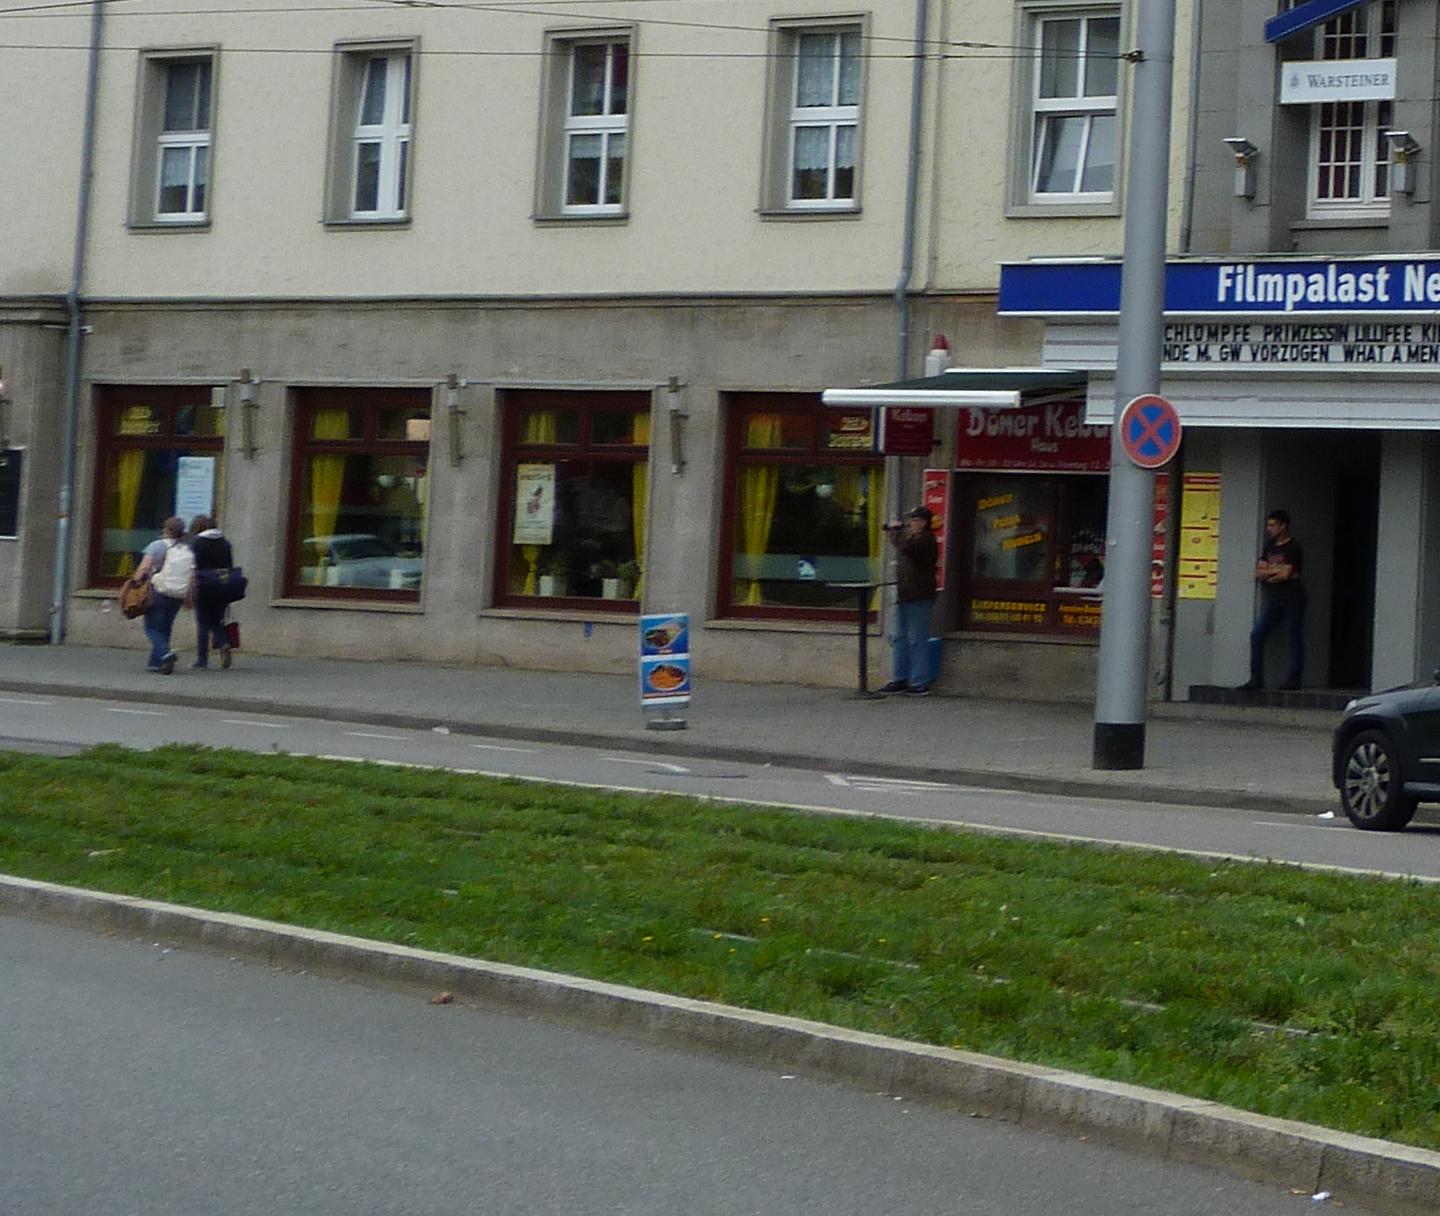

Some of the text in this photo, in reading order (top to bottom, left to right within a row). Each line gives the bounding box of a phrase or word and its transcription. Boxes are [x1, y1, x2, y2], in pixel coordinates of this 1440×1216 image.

[1306, 73, 1390, 88] WARSTEINER
[1217, 263, 1390, 312] Filmpalast
[1263, 324, 1349, 343] PRINZESSIN
[1219, 344, 1242, 361] GW
[1343, 344, 1386, 362] WHAT
[1391, 344, 1403, 362] A
[1407, 344, 1440, 362] MEN
